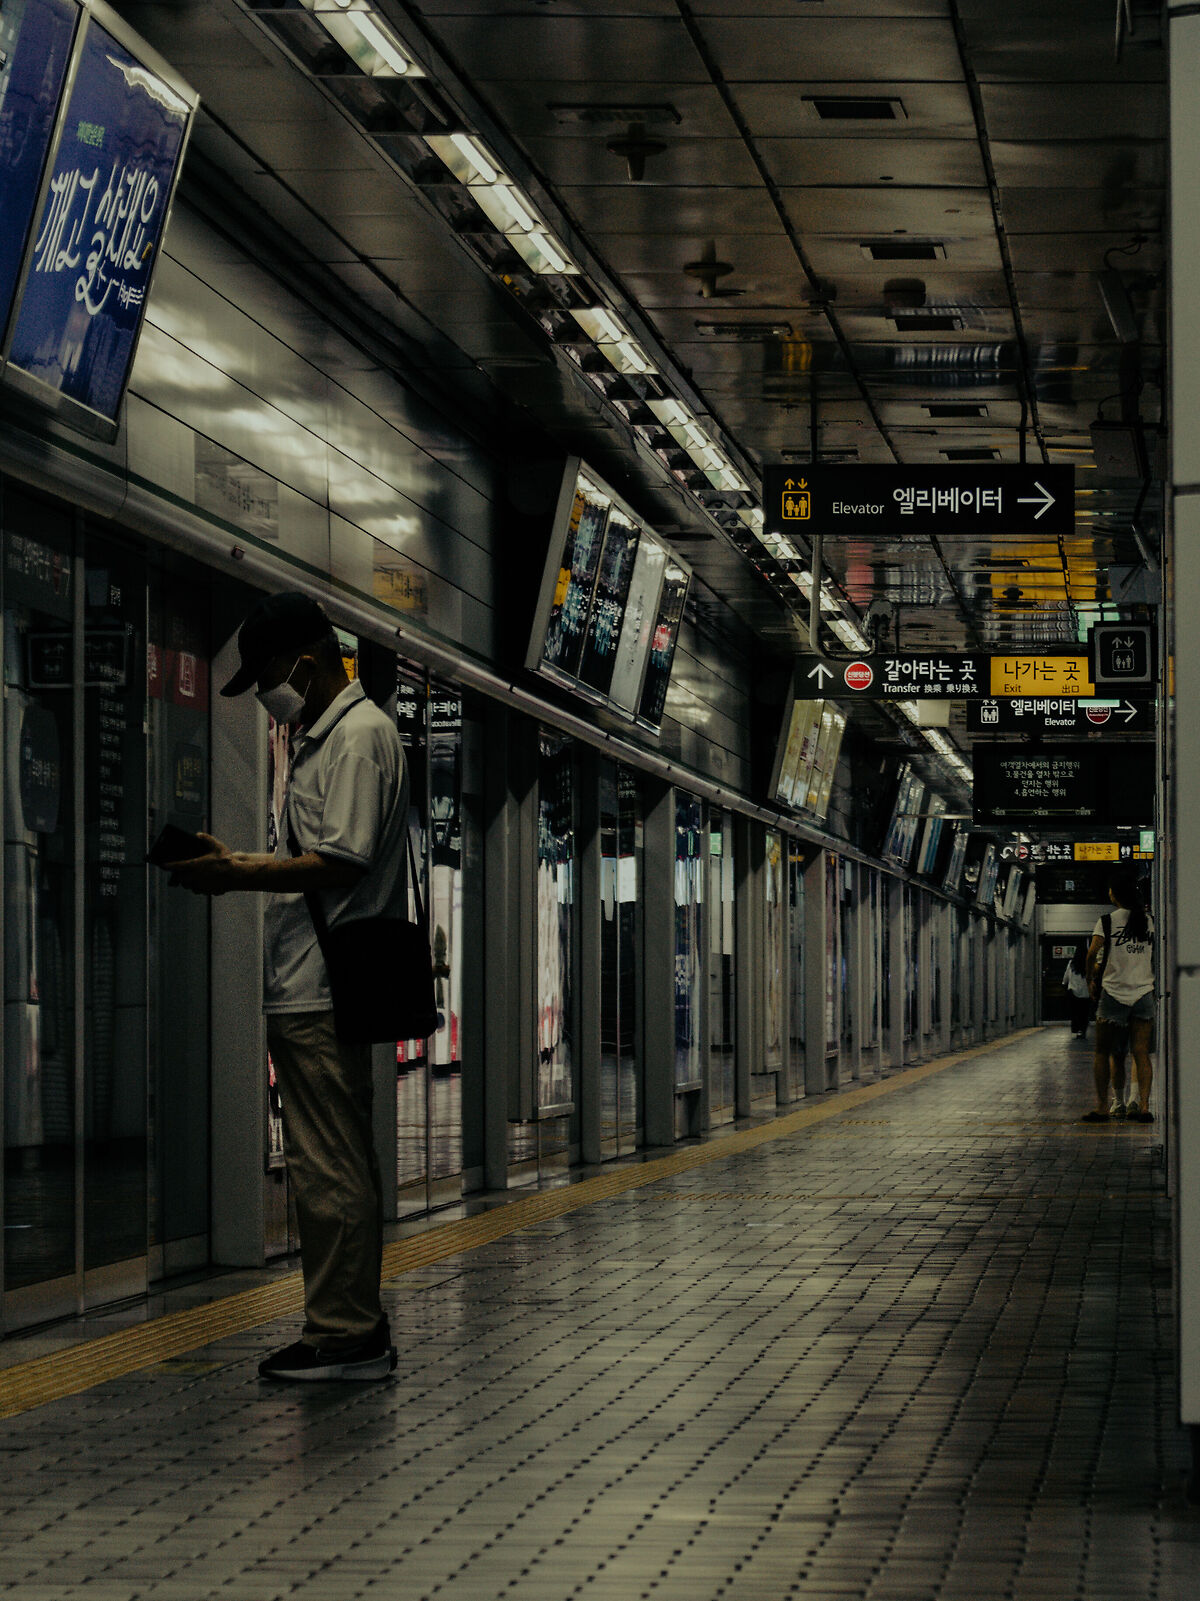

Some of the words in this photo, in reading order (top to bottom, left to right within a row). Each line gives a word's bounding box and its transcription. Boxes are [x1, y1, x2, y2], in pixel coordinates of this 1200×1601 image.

[832, 501, 885, 515] Elevator
[892, 487, 1002, 515] 엘리베이터
[884, 660, 954, 681] 갈아타는
[959, 661, 977, 681] 곳
[1004, 661, 1057, 681] 나가는
[1063, 661, 1081, 681] 곳
[882, 683, 921, 693] Transfer
[1004, 684, 1022, 693] Exit
[1062, 684, 1080, 693] 出口
[1010, 699, 1076, 717] 엘리베이터
[1044, 717, 1076, 726] Elevator
